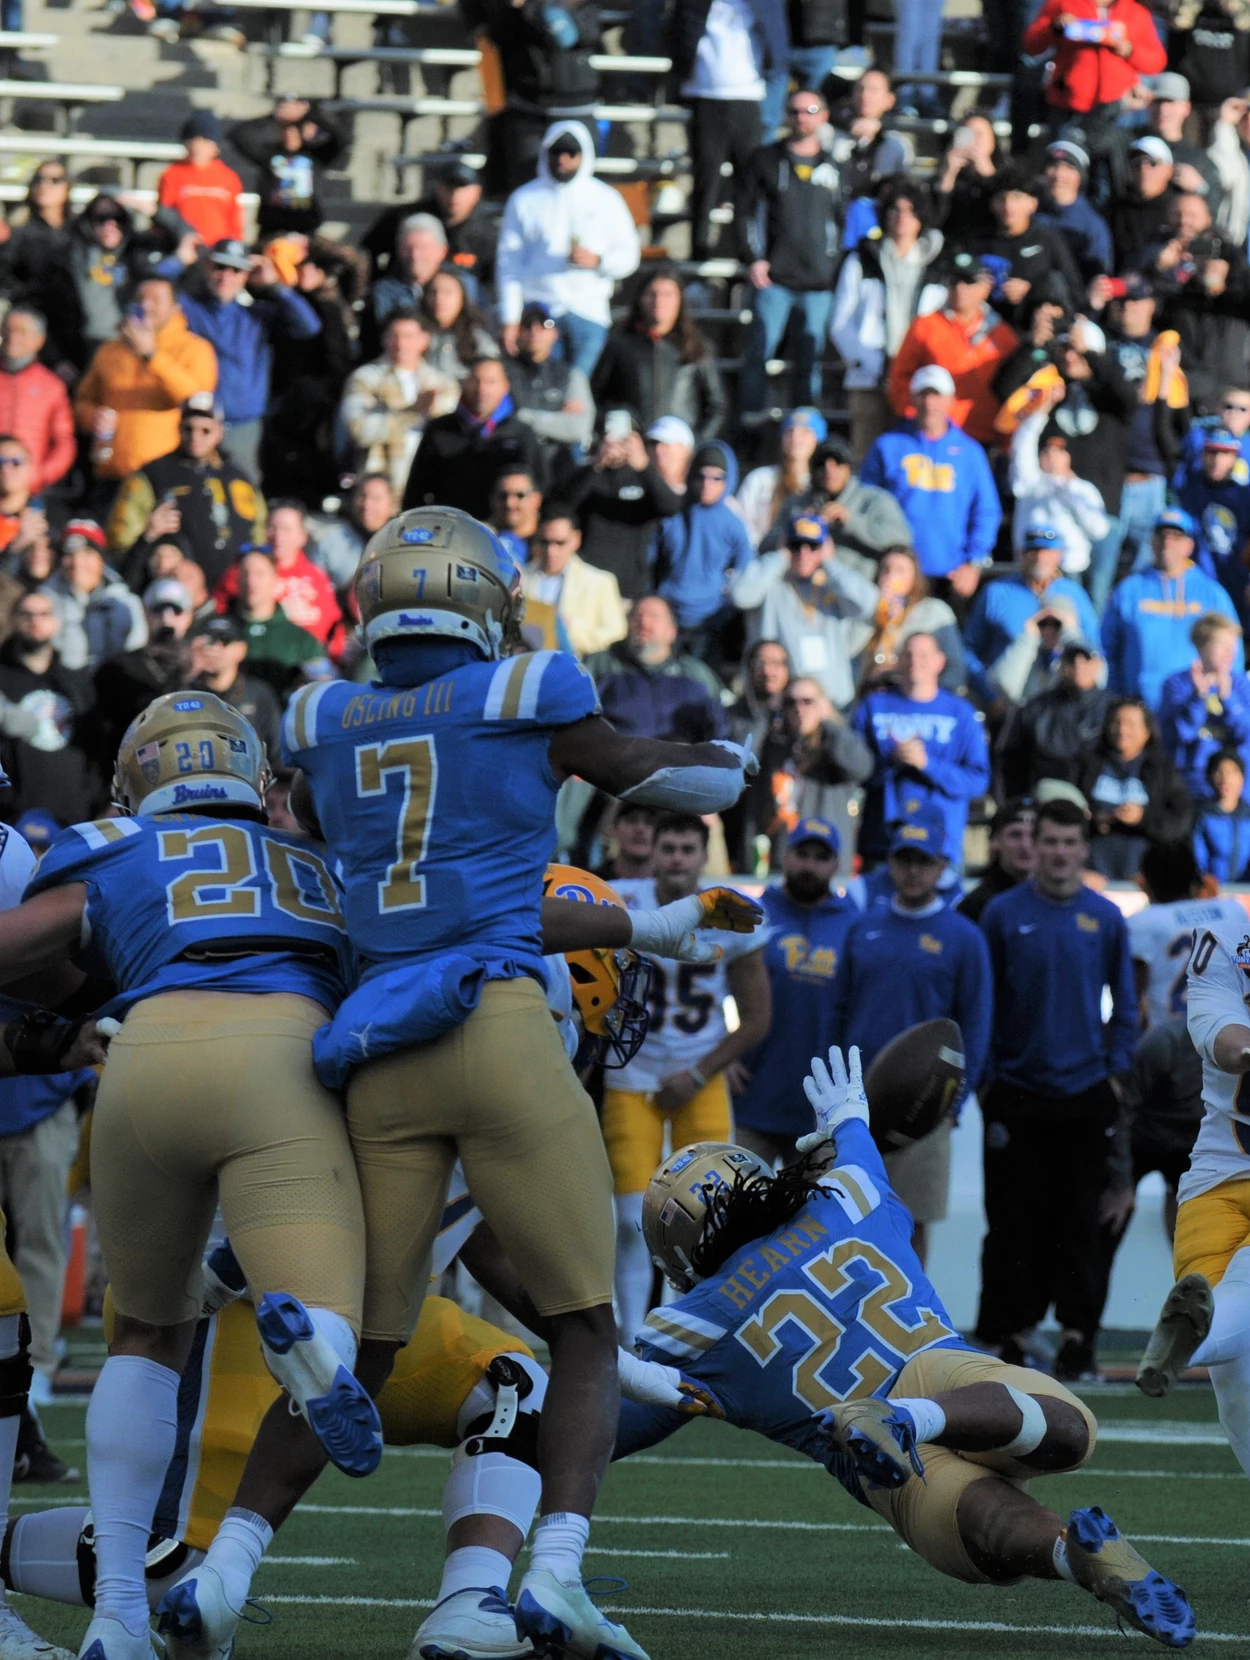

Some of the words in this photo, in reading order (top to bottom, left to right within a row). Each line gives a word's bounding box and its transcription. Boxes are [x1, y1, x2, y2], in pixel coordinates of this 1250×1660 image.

[413, 569, 427, 600] 7
[341, 688, 417, 730] OSLING
[423, 681, 455, 716] III
[175, 740, 216, 773] 20
[172, 783, 229, 805] Bruins
[354, 733, 439, 915] 7
[155, 823, 349, 936] 20
[1192, 928, 1218, 976] 0
[689, 1169, 731, 1207] 22
[719, 1214, 829, 1310] HEARN
[733, 1237, 963, 1416] 22
